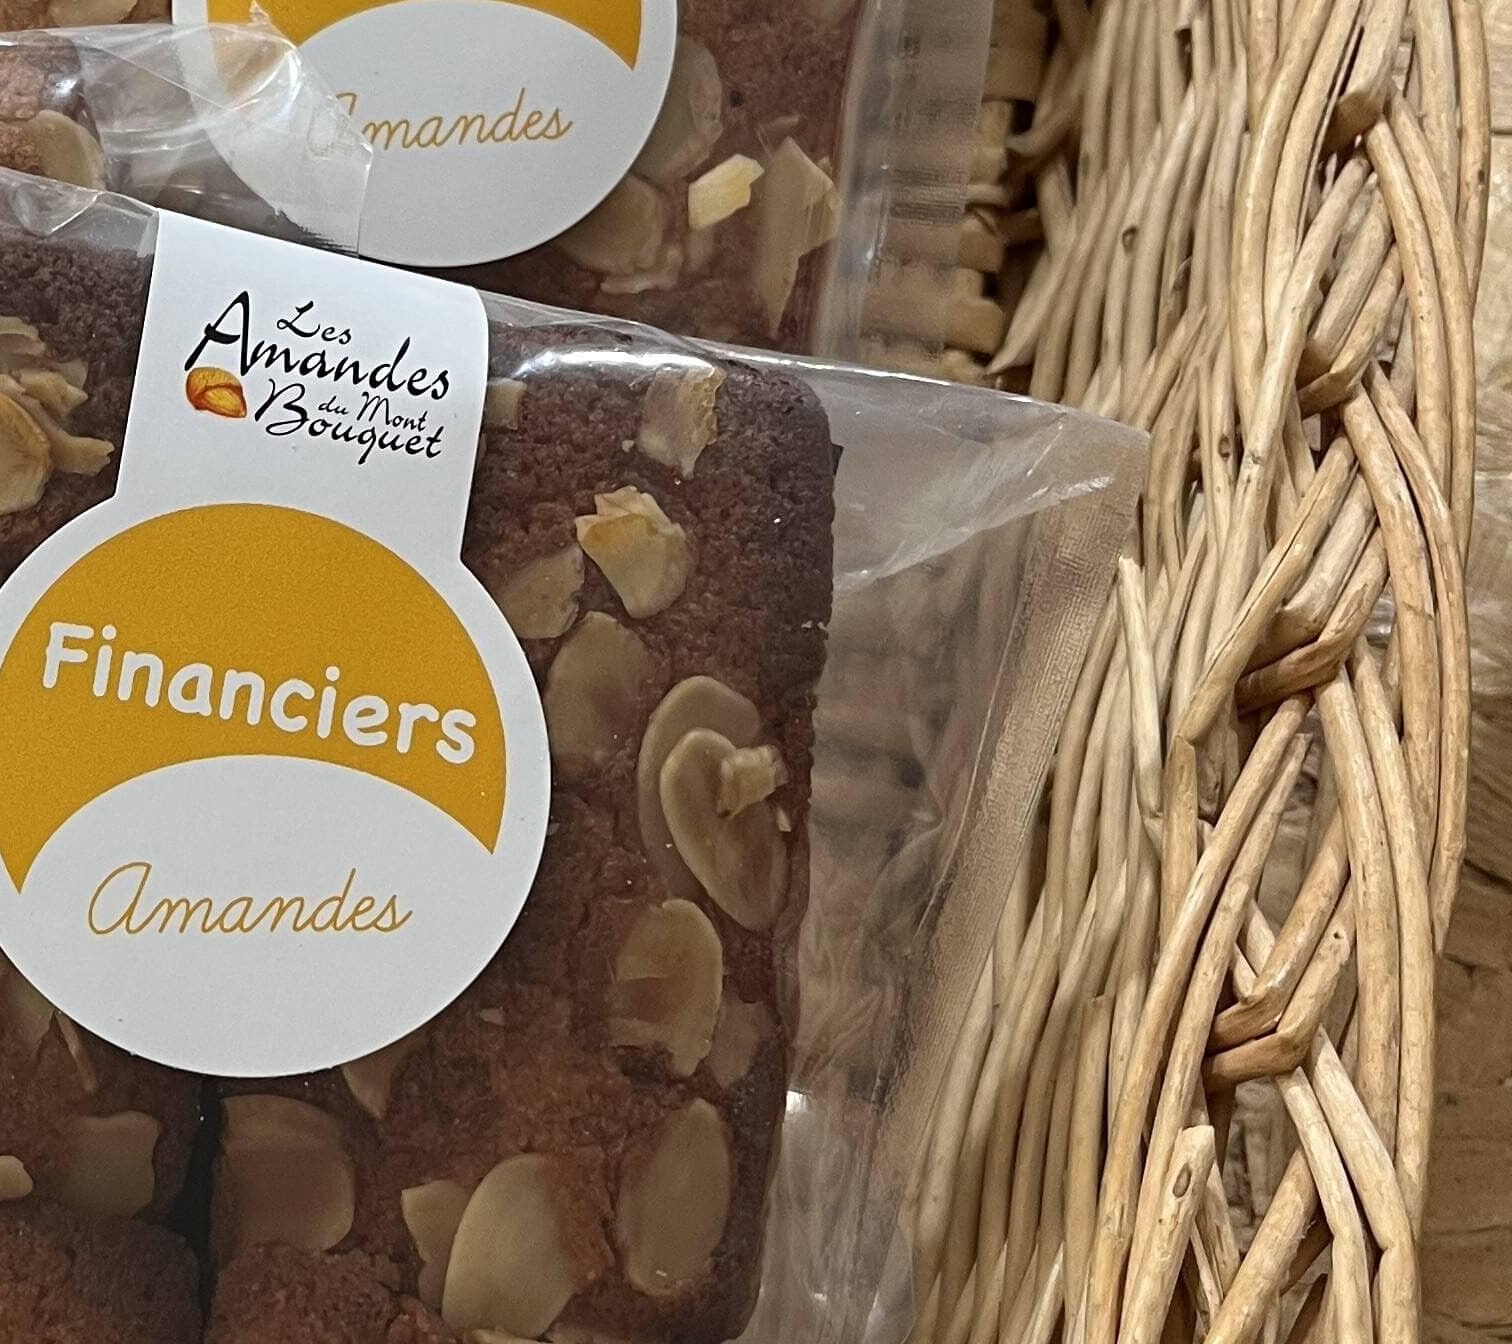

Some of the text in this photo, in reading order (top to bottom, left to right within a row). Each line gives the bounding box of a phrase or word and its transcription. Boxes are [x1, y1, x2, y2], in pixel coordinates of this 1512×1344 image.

[184, 290, 450, 401] Amandes
[276, 300, 352, 346] Les
[254, 377, 445, 465] Bouquet
[317, 391, 428, 433] du Mont
[42, 621, 477, 764] Financiers
[87, 861, 414, 935] Amandes
